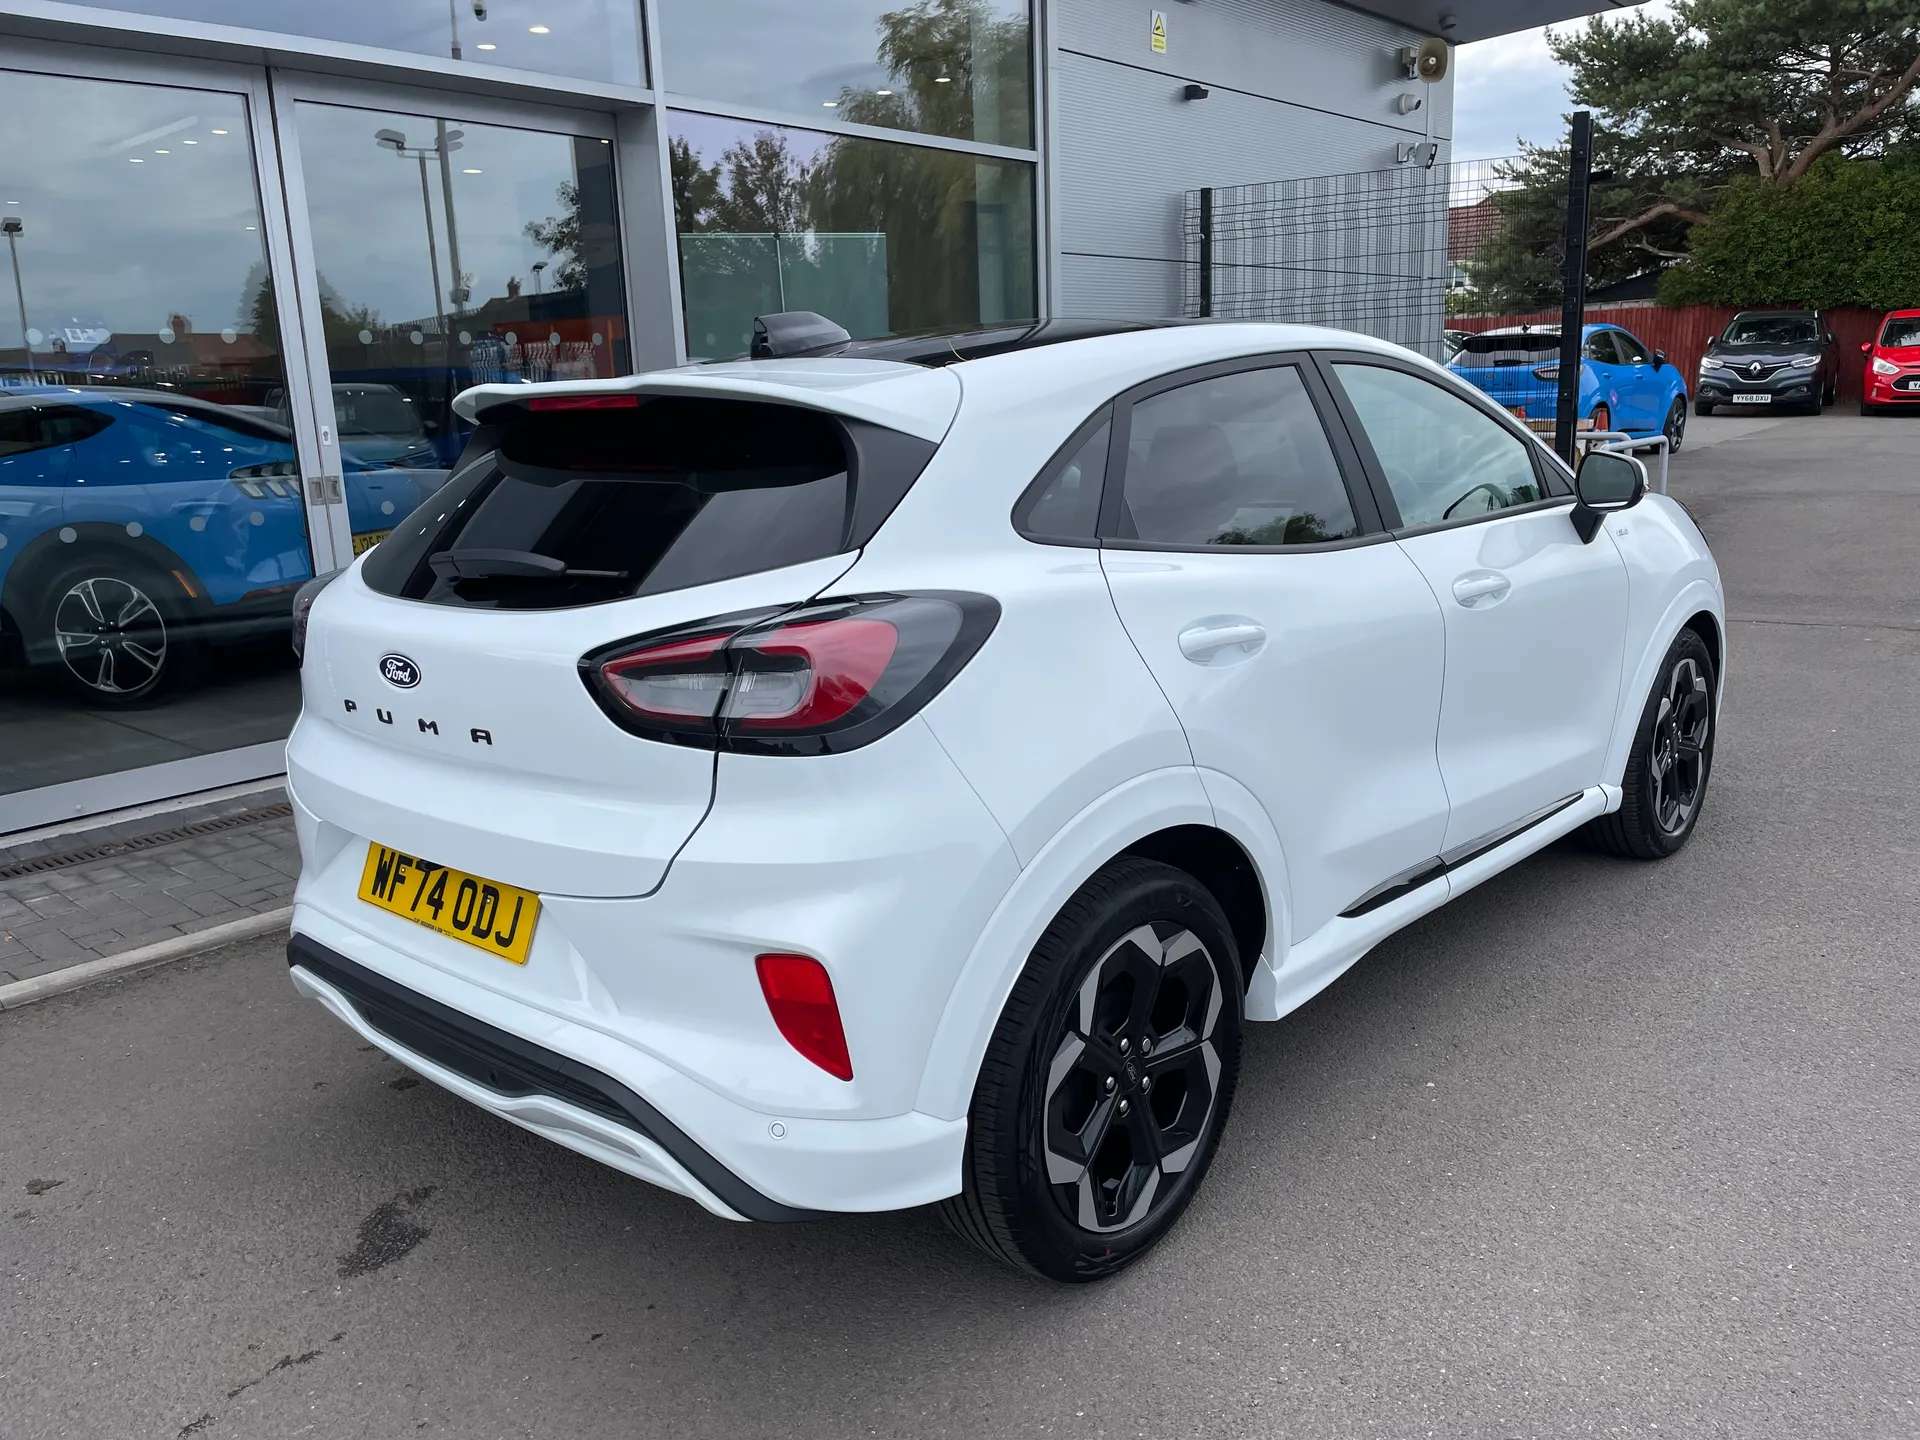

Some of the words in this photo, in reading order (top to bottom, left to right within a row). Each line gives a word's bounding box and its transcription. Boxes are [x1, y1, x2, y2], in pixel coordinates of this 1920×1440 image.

[384, 658, 411, 682] Ford
[344, 699, 492, 745] PUMA
[371, 847, 449, 921] WF74
[452, 877, 524, 948] ODJ
